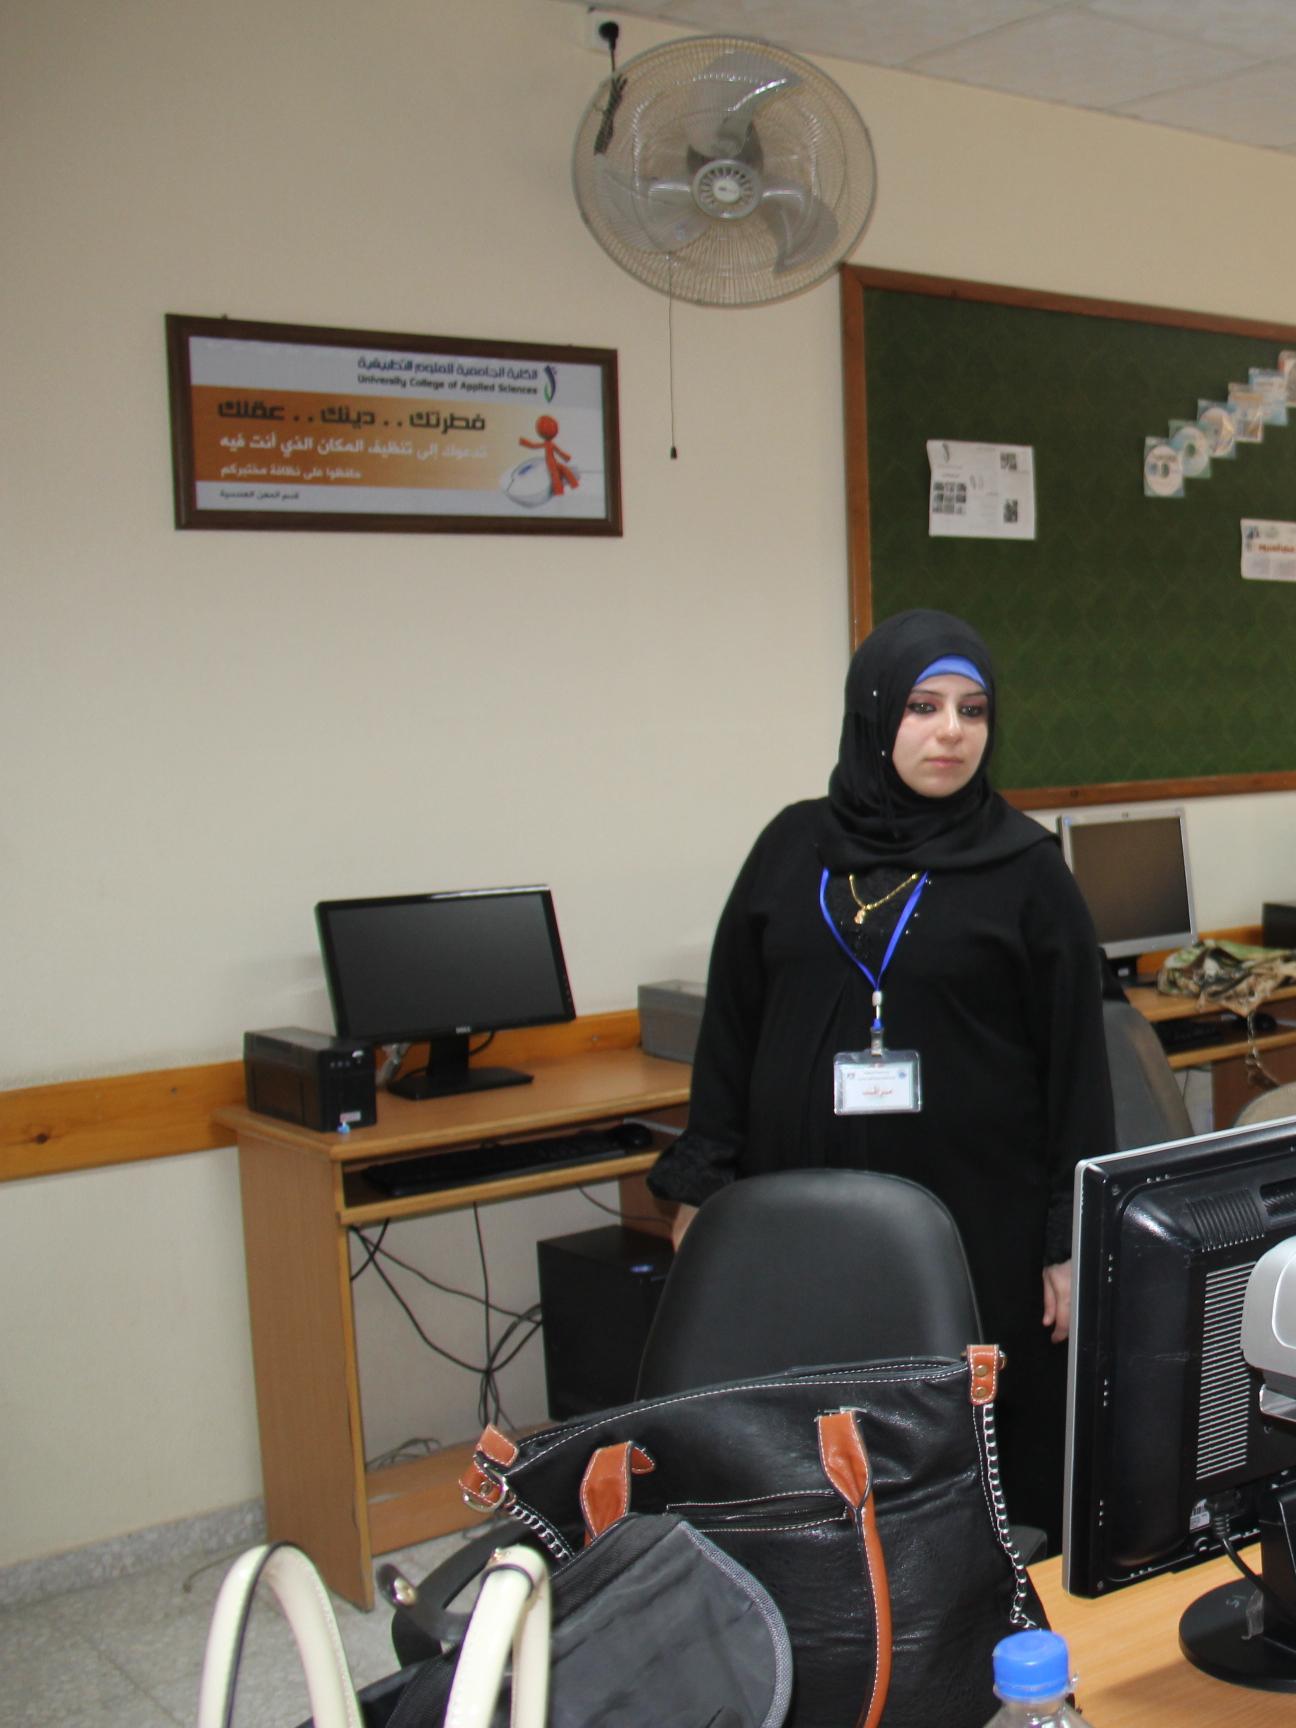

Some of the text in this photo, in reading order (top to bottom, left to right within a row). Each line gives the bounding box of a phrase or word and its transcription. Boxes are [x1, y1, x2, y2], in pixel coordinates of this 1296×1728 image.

[358, 374, 538, 395] University College of Applied Sciences
[217, 400, 486, 434] فطرتك دينك عقلك
[220, 434, 246, 453] فيه
[249, 431, 277, 449] أنت
[280, 434, 314, 459] الذي
[317, 436, 365, 455] المكان
